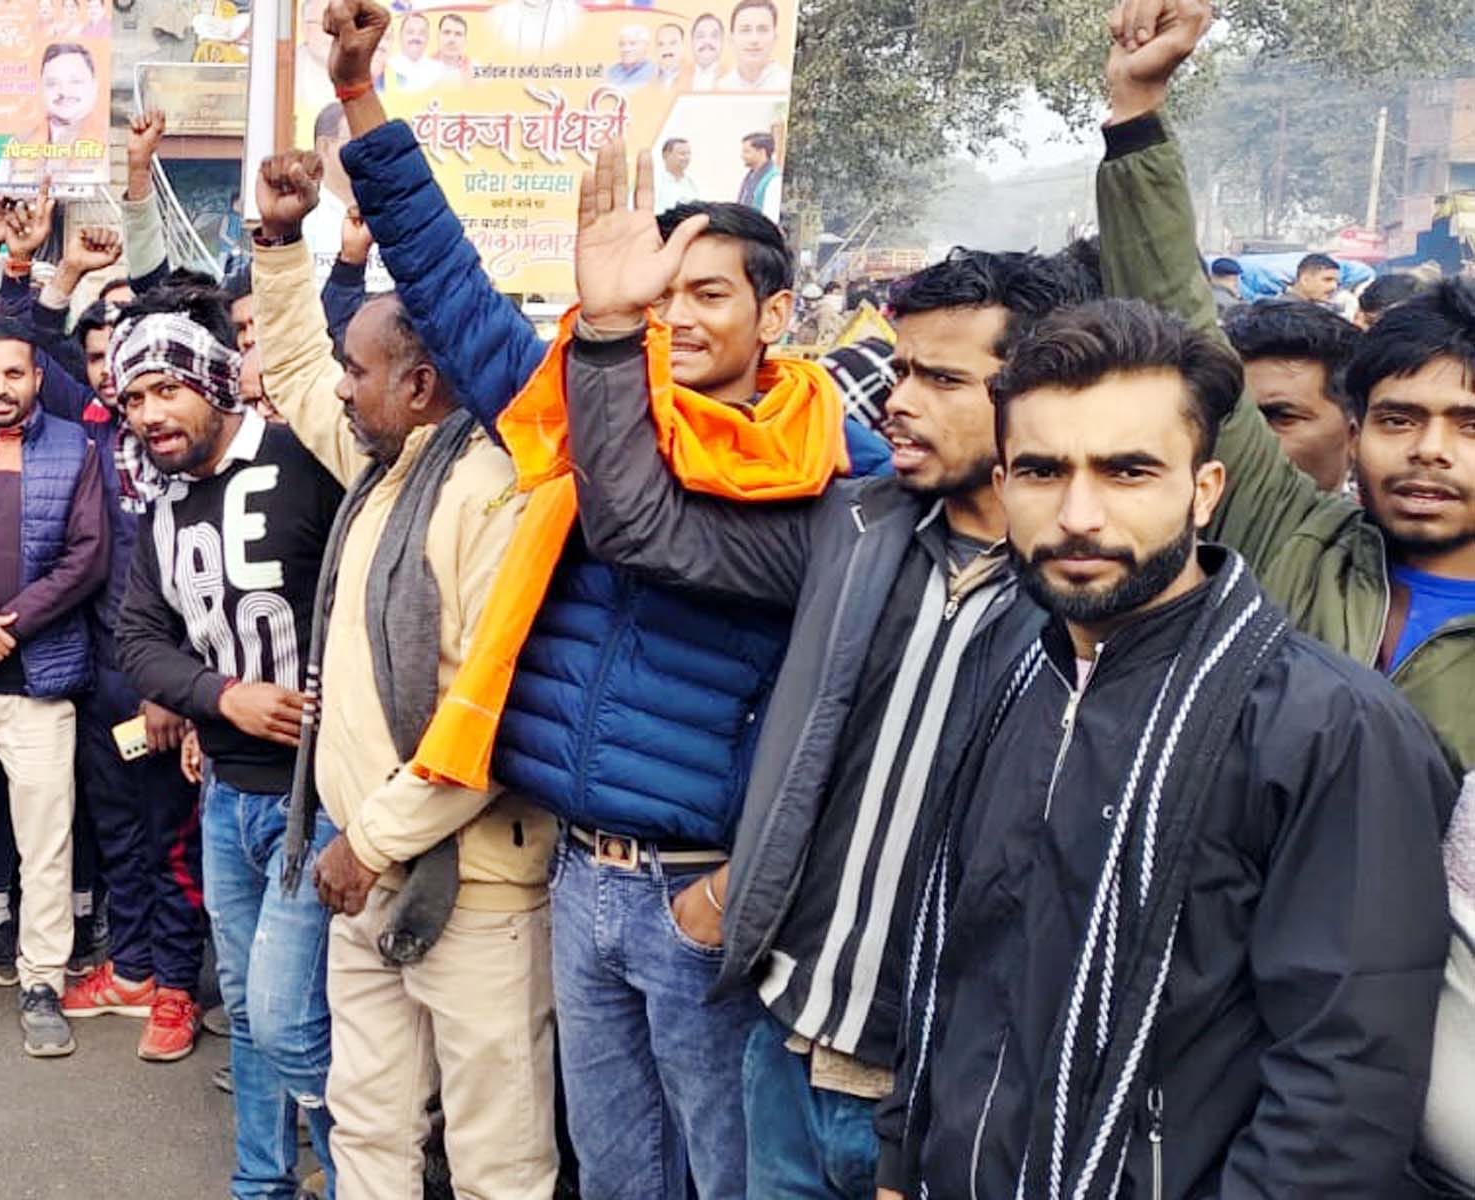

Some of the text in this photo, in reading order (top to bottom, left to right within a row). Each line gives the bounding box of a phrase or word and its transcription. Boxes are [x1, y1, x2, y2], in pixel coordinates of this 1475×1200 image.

[414, 87, 628, 160] पंकज चौधरी
[464, 168, 574, 192] प्रदेश अध्यक्ष
